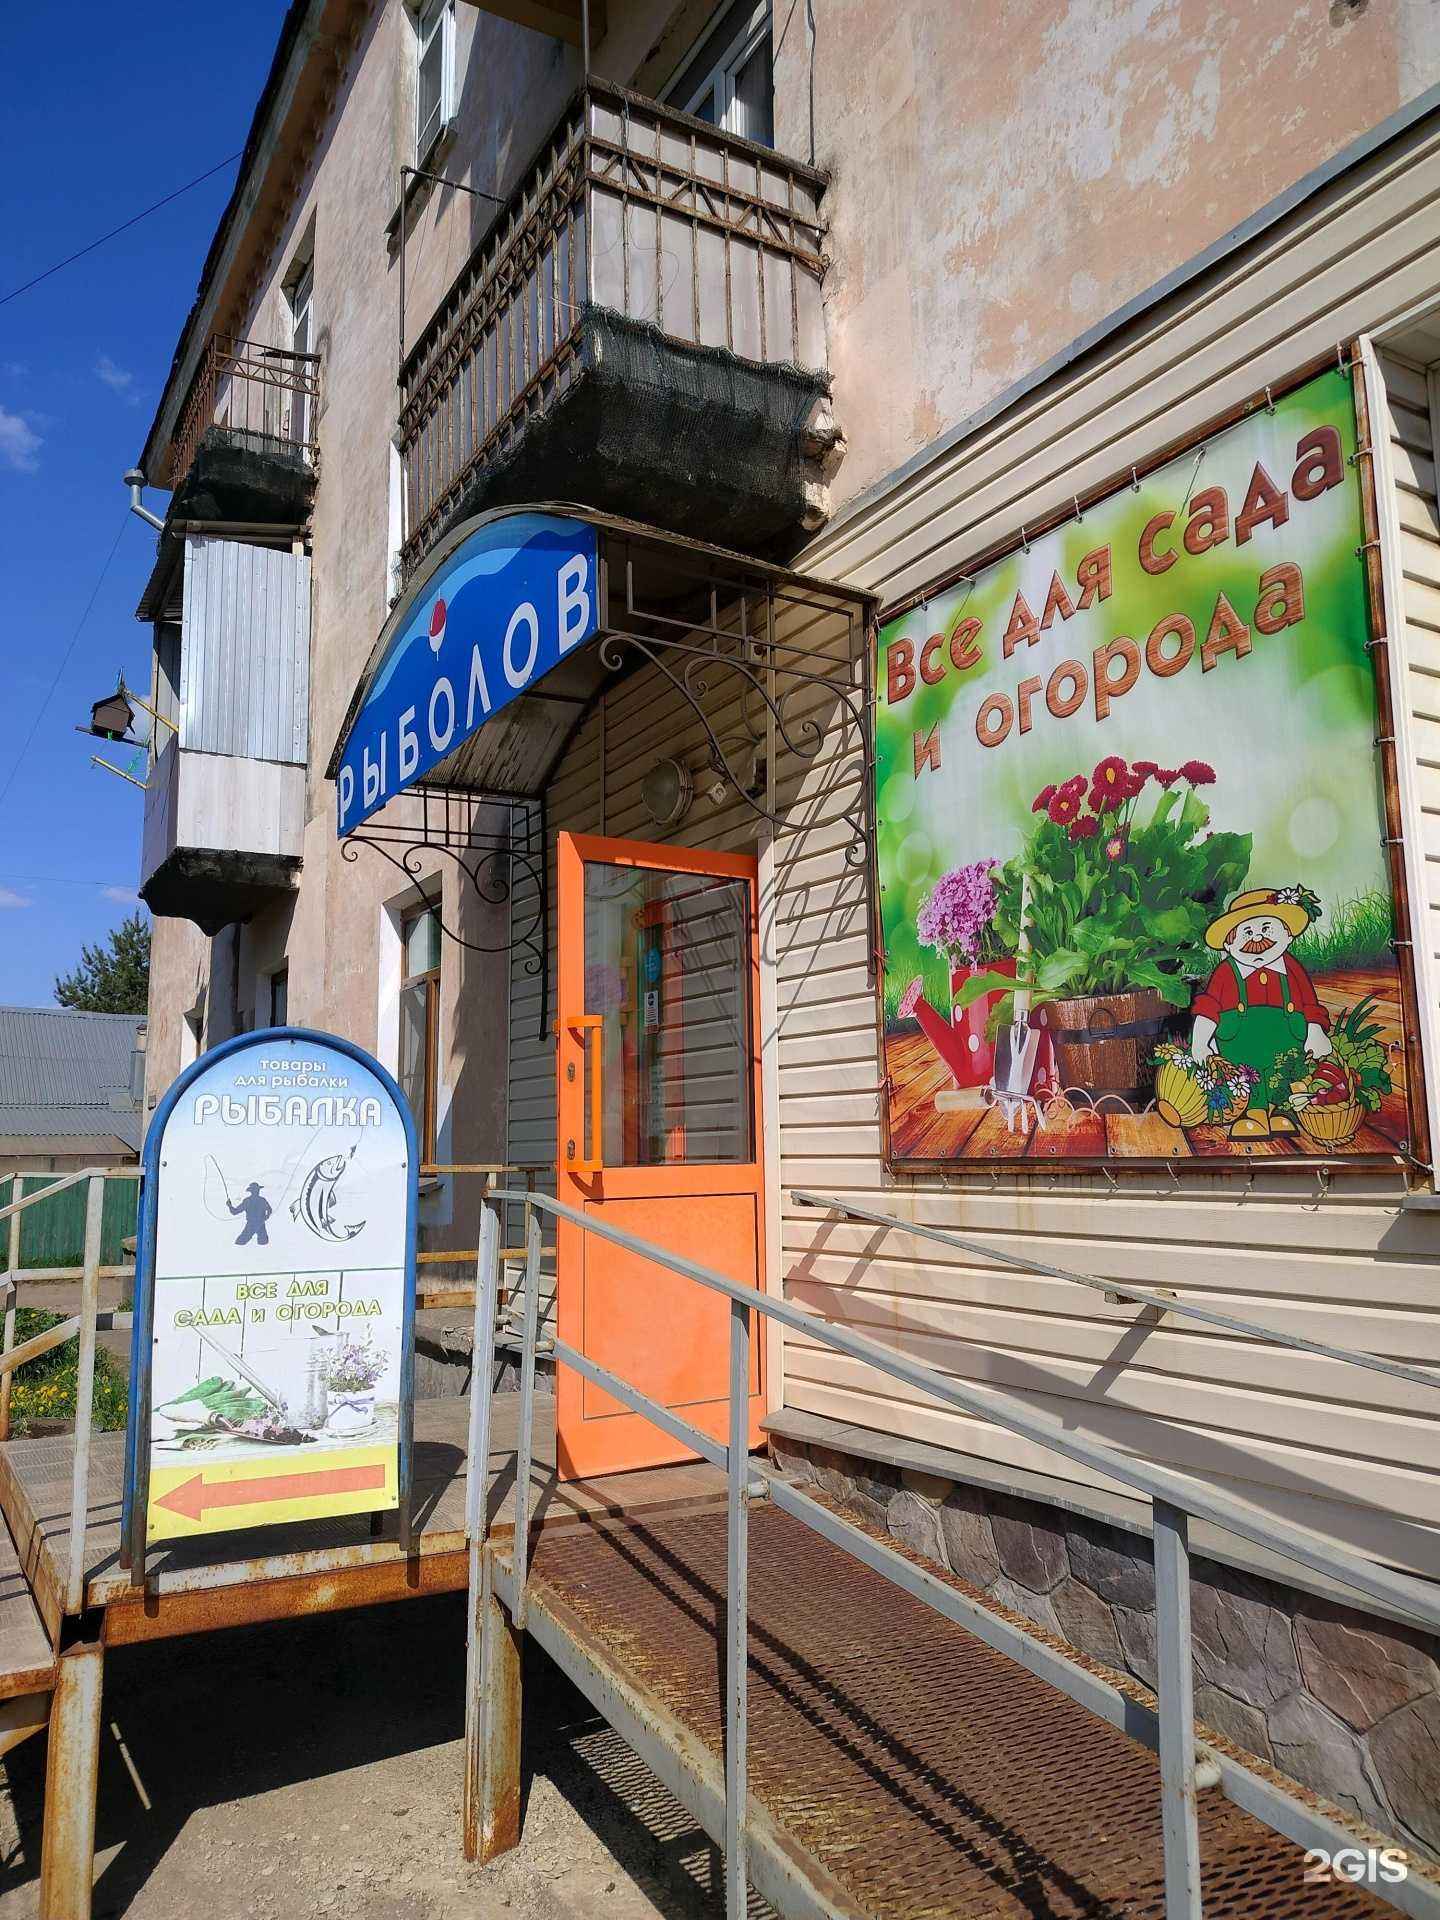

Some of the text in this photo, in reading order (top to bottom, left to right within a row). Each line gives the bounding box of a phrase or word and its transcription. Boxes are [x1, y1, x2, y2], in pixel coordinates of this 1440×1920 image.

[887, 425, 1346, 705] Все для сада
[976, 562, 1305, 748] огорода
[339, 553, 590, 828] РЫБОЛОВ
[234, 1073, 349, 1089] для рыбалки
[259, 1060, 327, 1072] товары
[194, 1094, 382, 1127] РЫБАЛКА
[236, 1280, 329, 1300] ВСЕ ДЛЯ
[174, 1307, 241, 1328] САДА
[275, 1299, 382, 1321] ОГОРОДА
